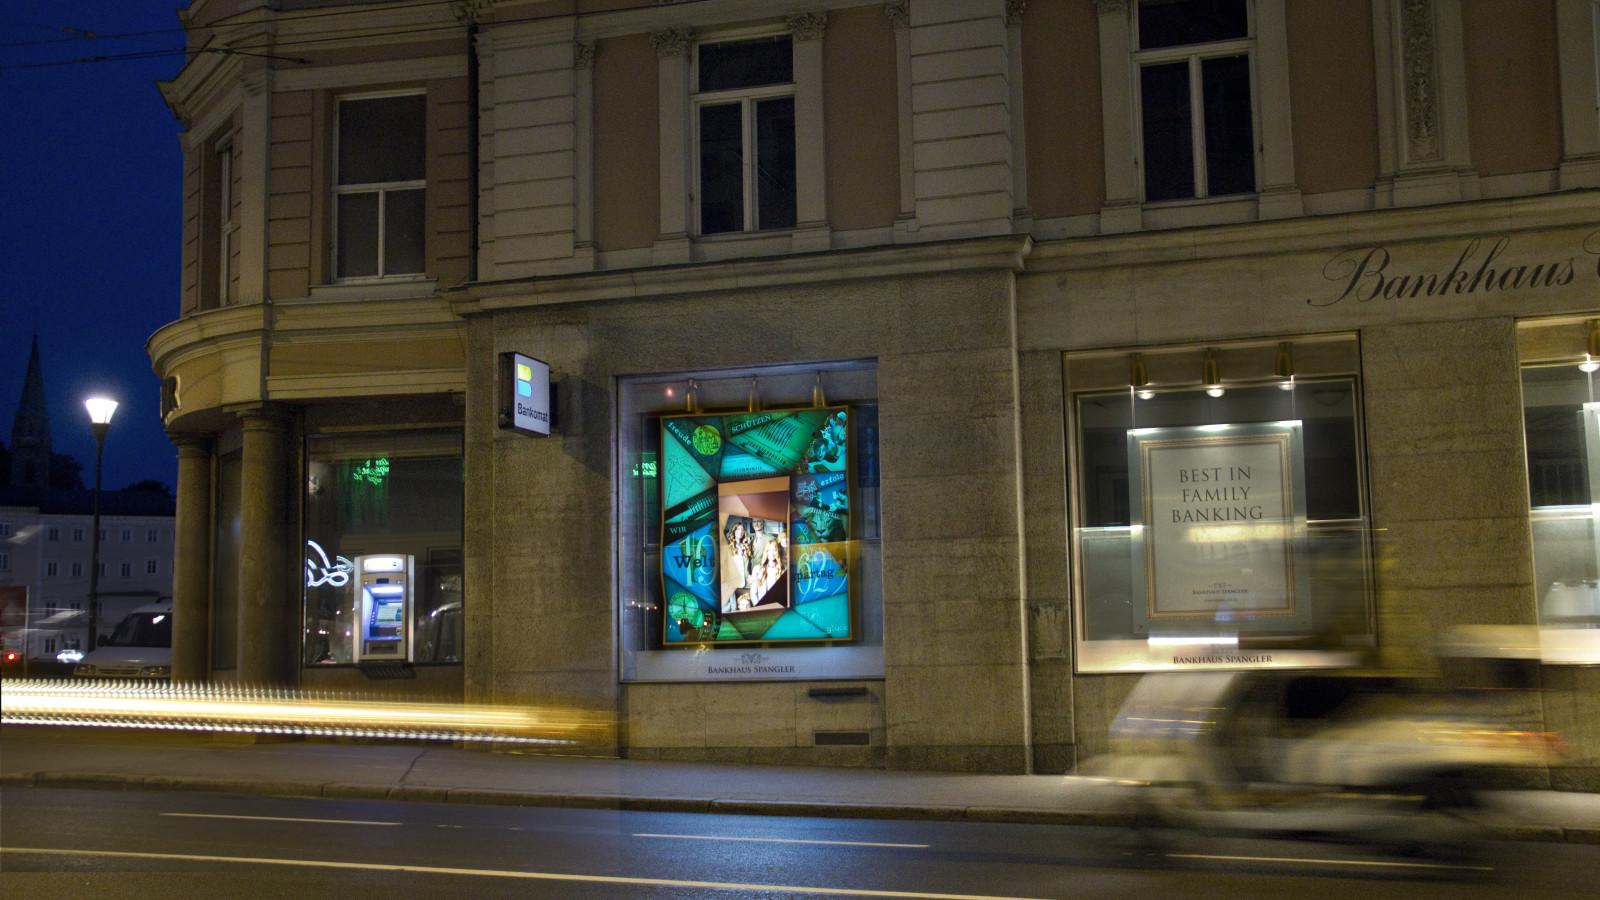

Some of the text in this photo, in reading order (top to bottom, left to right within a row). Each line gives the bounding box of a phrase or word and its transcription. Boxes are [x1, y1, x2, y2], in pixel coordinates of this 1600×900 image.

[1307, 236, 1574, 307] Bankhaus
[517, 402, 548, 422] Bankomat
[820, 473, 845, 486] erfolg
[1180, 465, 1251, 483] BEST IN
[1182, 486, 1251, 502] FAMILY
[1172, 505, 1263, 523] BANKING
[669, 526, 687, 535] WIR
[673, 555, 715, 569] Welt
[1173, 655, 1223, 664] BANKHAUS
[708, 665, 752, 674] BANKHAUS
